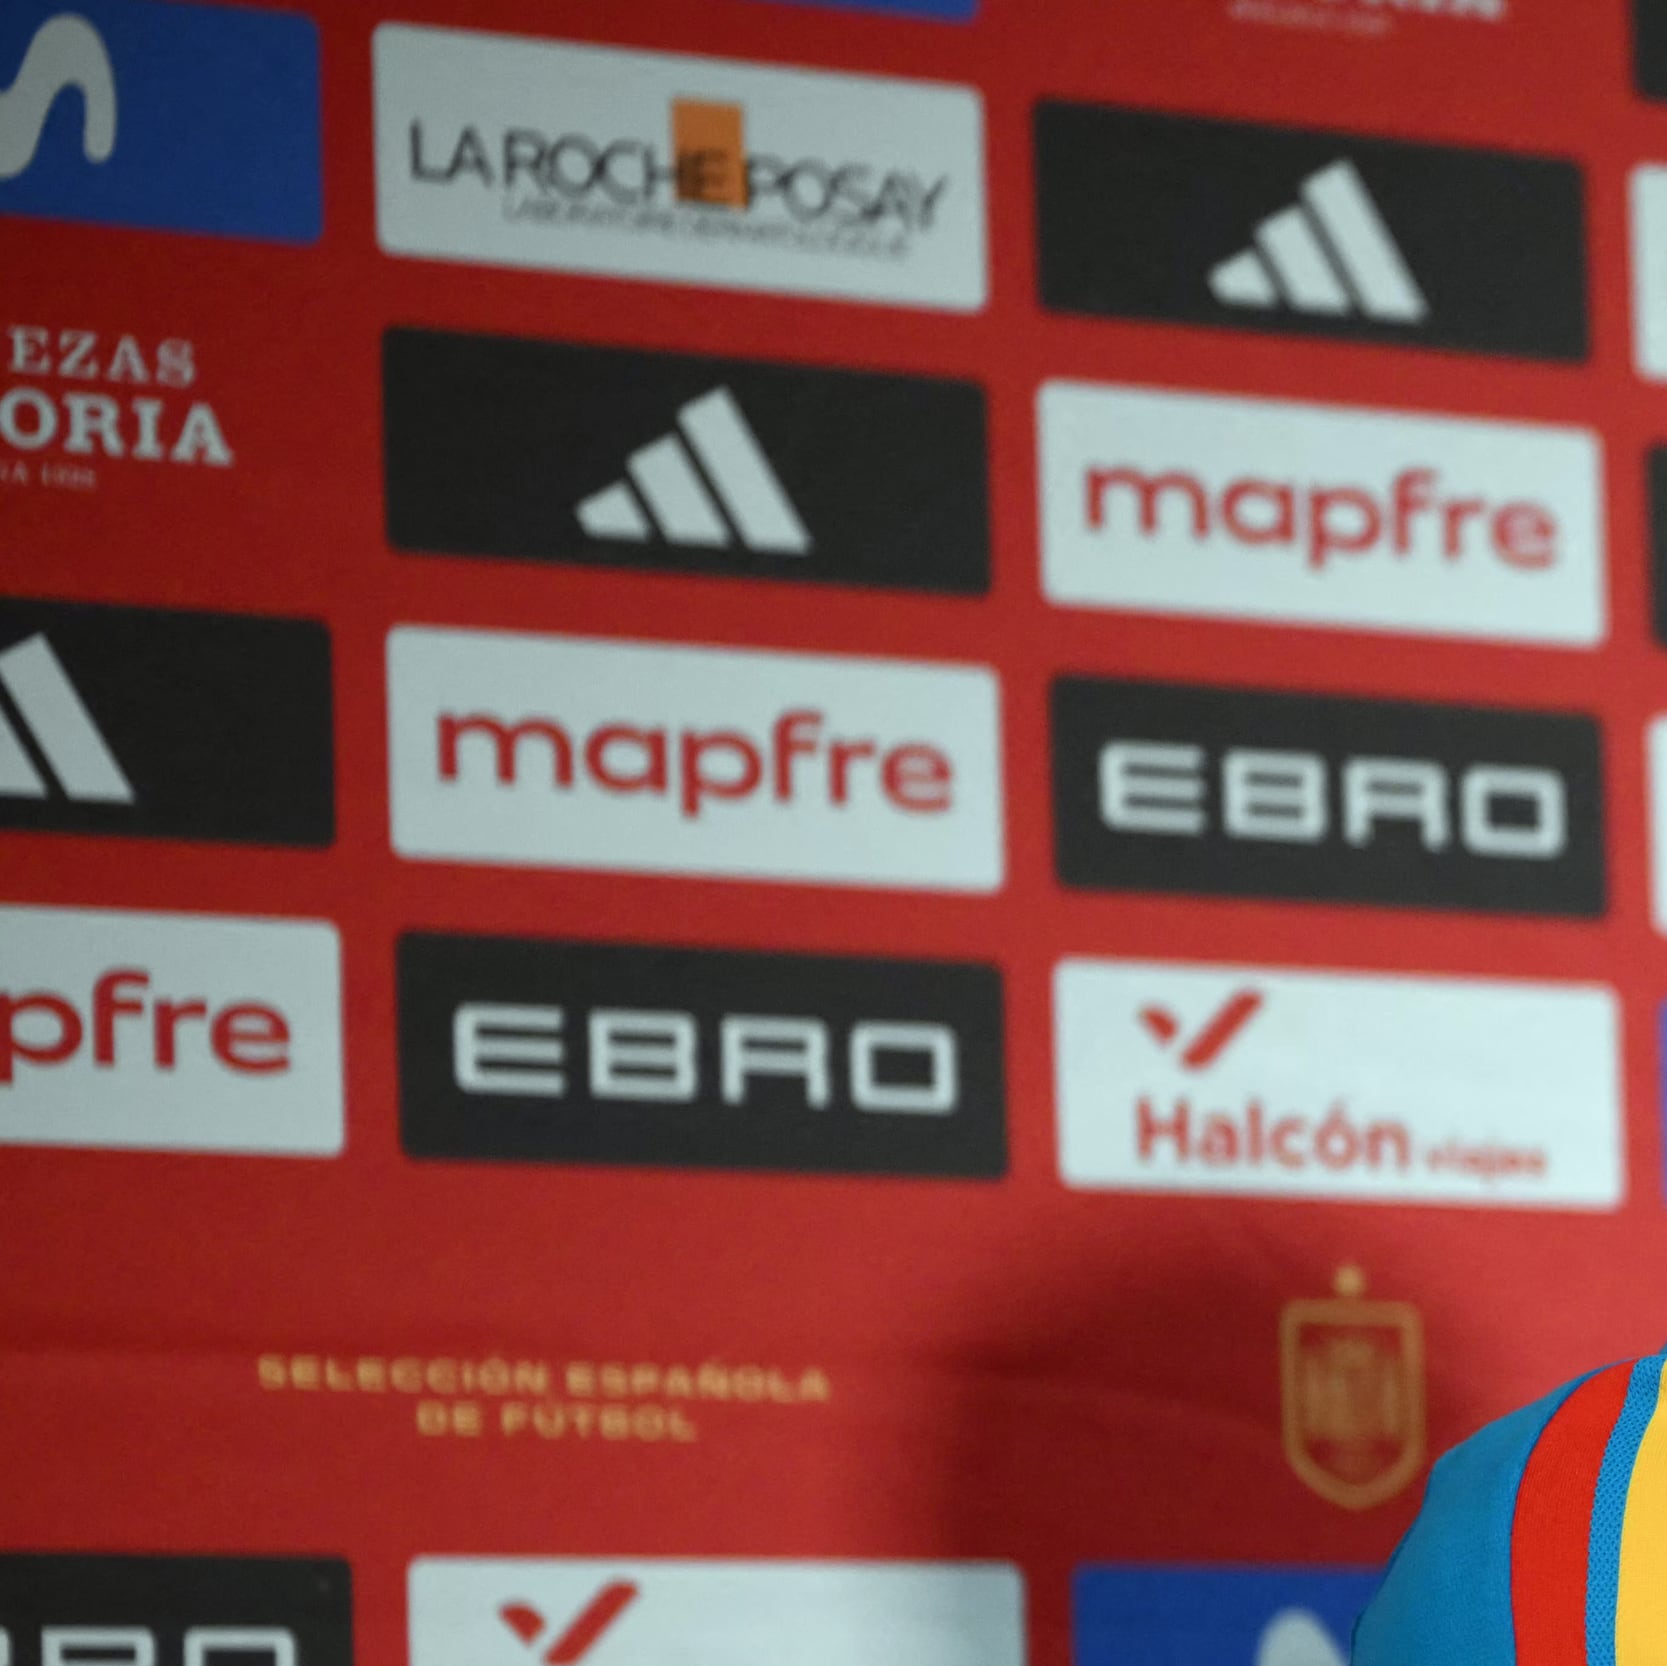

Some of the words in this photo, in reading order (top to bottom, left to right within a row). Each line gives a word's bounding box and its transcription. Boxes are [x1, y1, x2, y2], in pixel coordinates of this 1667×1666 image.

[409, 118, 494, 188] LA
[9, 325, 195, 389] EZAS
[0, 386, 234, 467] ORIA
[1084, 466, 1555, 568] mapfre
[437, 712, 951, 817] mapfre
[1100, 742, 1565, 857] EBRO
[0, 970, 290, 1085] pfre
[454, 1005, 958, 1113] EBRO
[1135, 1096, 1411, 1170] Halcón
[258, 1352, 550, 1396] SELECCIÓN
[566, 1360, 831, 1403] ESPAÑOLA
[416, 1403, 481, 1436] DE
[500, 1400, 695, 1441] FÚTBOL
